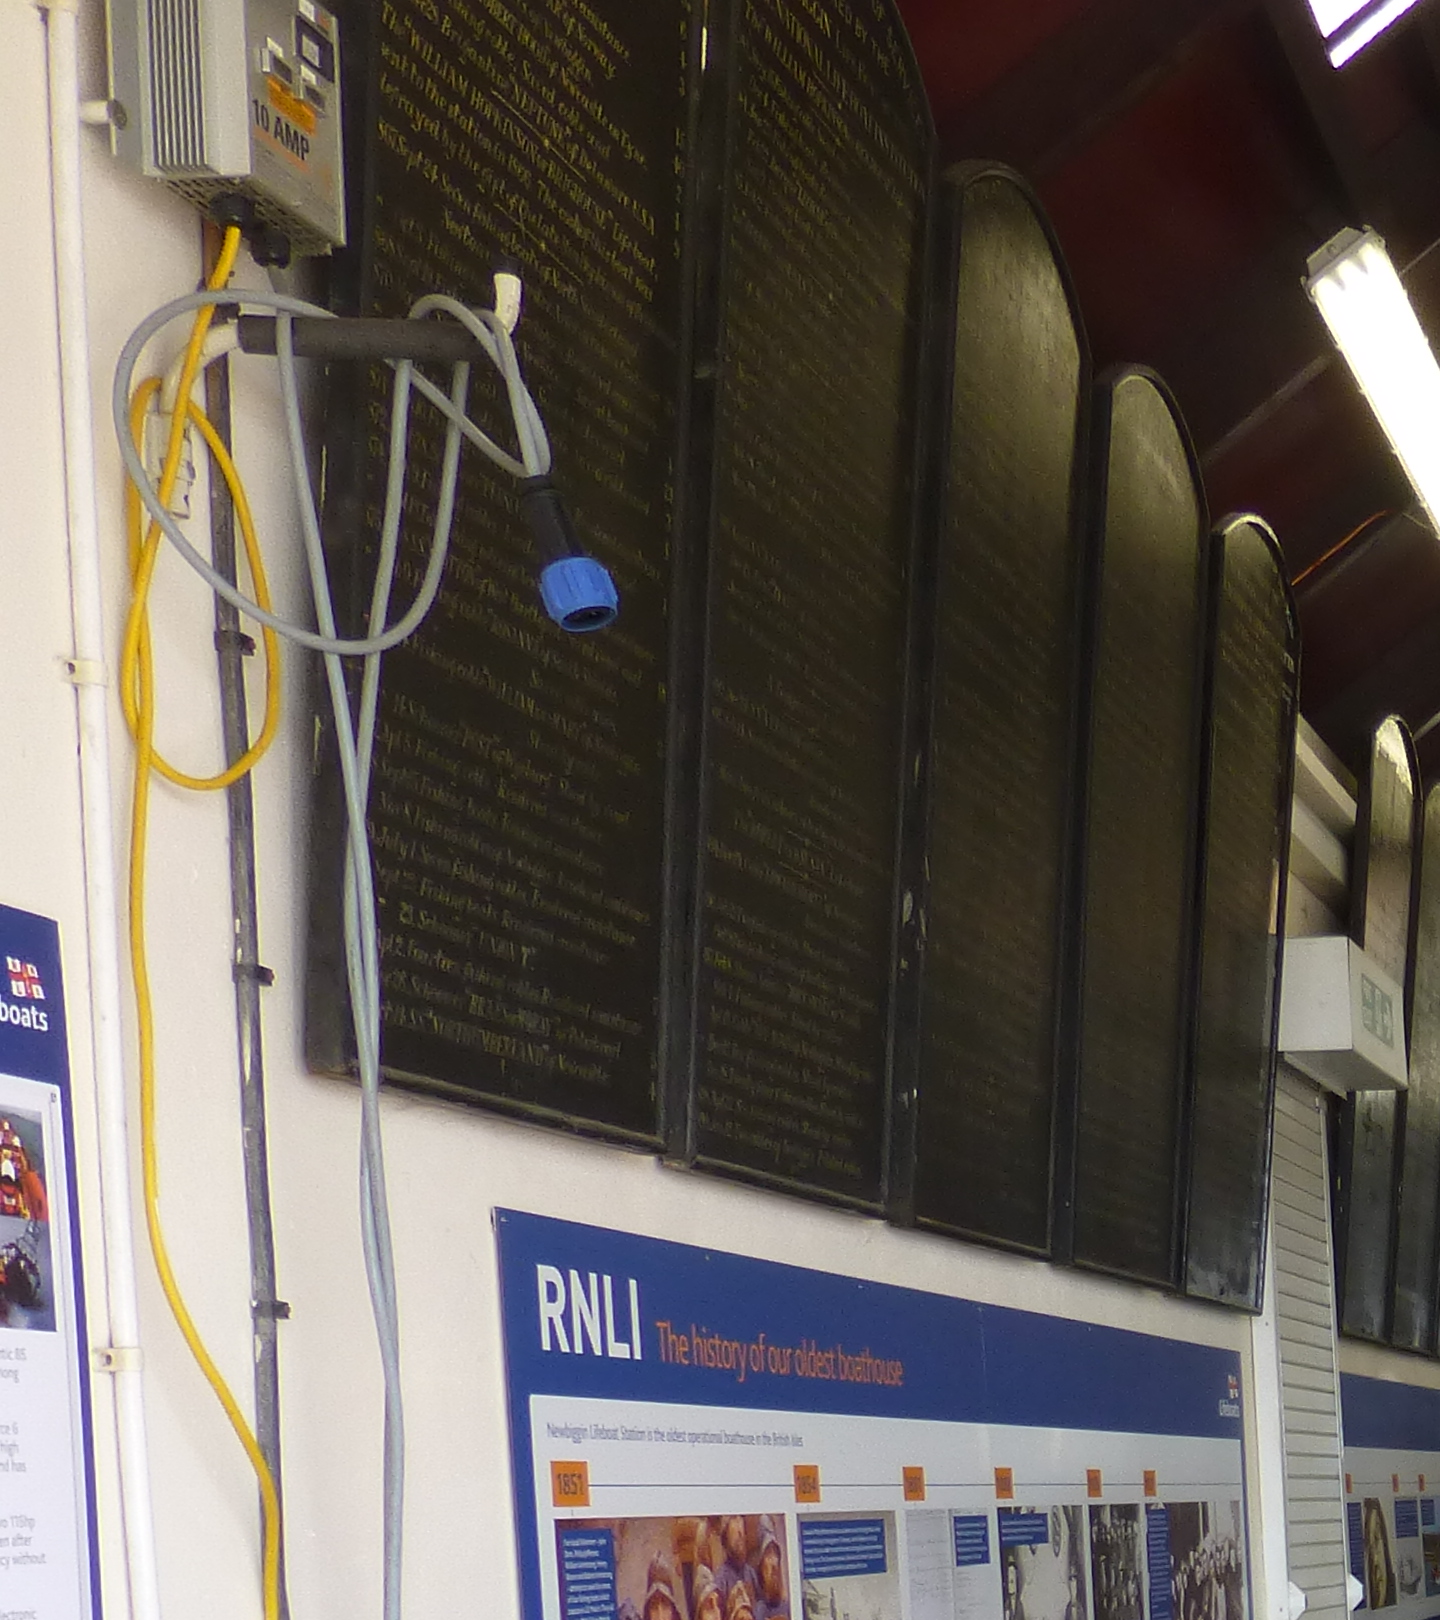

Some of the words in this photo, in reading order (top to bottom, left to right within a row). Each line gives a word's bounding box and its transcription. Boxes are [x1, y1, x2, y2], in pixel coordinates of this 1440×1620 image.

[252, 99, 269, 132] 10
[274, 117, 310, 161] AMP
[537, 1264, 642, 1360] RNLI
[656, 1320, 689, 1364] The
[691, 1323, 747, 1383] history
[749, 1333, 768, 1373] of
[768, 1342, 792, 1374] our
[795, 1338, 835, 1380] oldest
[836, 1344, 904, 1387] boathouse
[546, 1423, 588, 1444] Newbiggin
[589, 1425, 618, 1441] Lifeboat
[620, 1426, 645, 1442] Station
[647, 1428, 653, 1441] is
[654, 1428, 665, 1443] the
[666, 1428, 687, 1444] oldest
[687, 1430, 723, 1448] operational
[724, 1430, 754, 1446] boathouse
[762, 1432, 773, 1446] the
[773, 1432, 791, 1447] British
[557, 1473, 585, 1496] 1851
